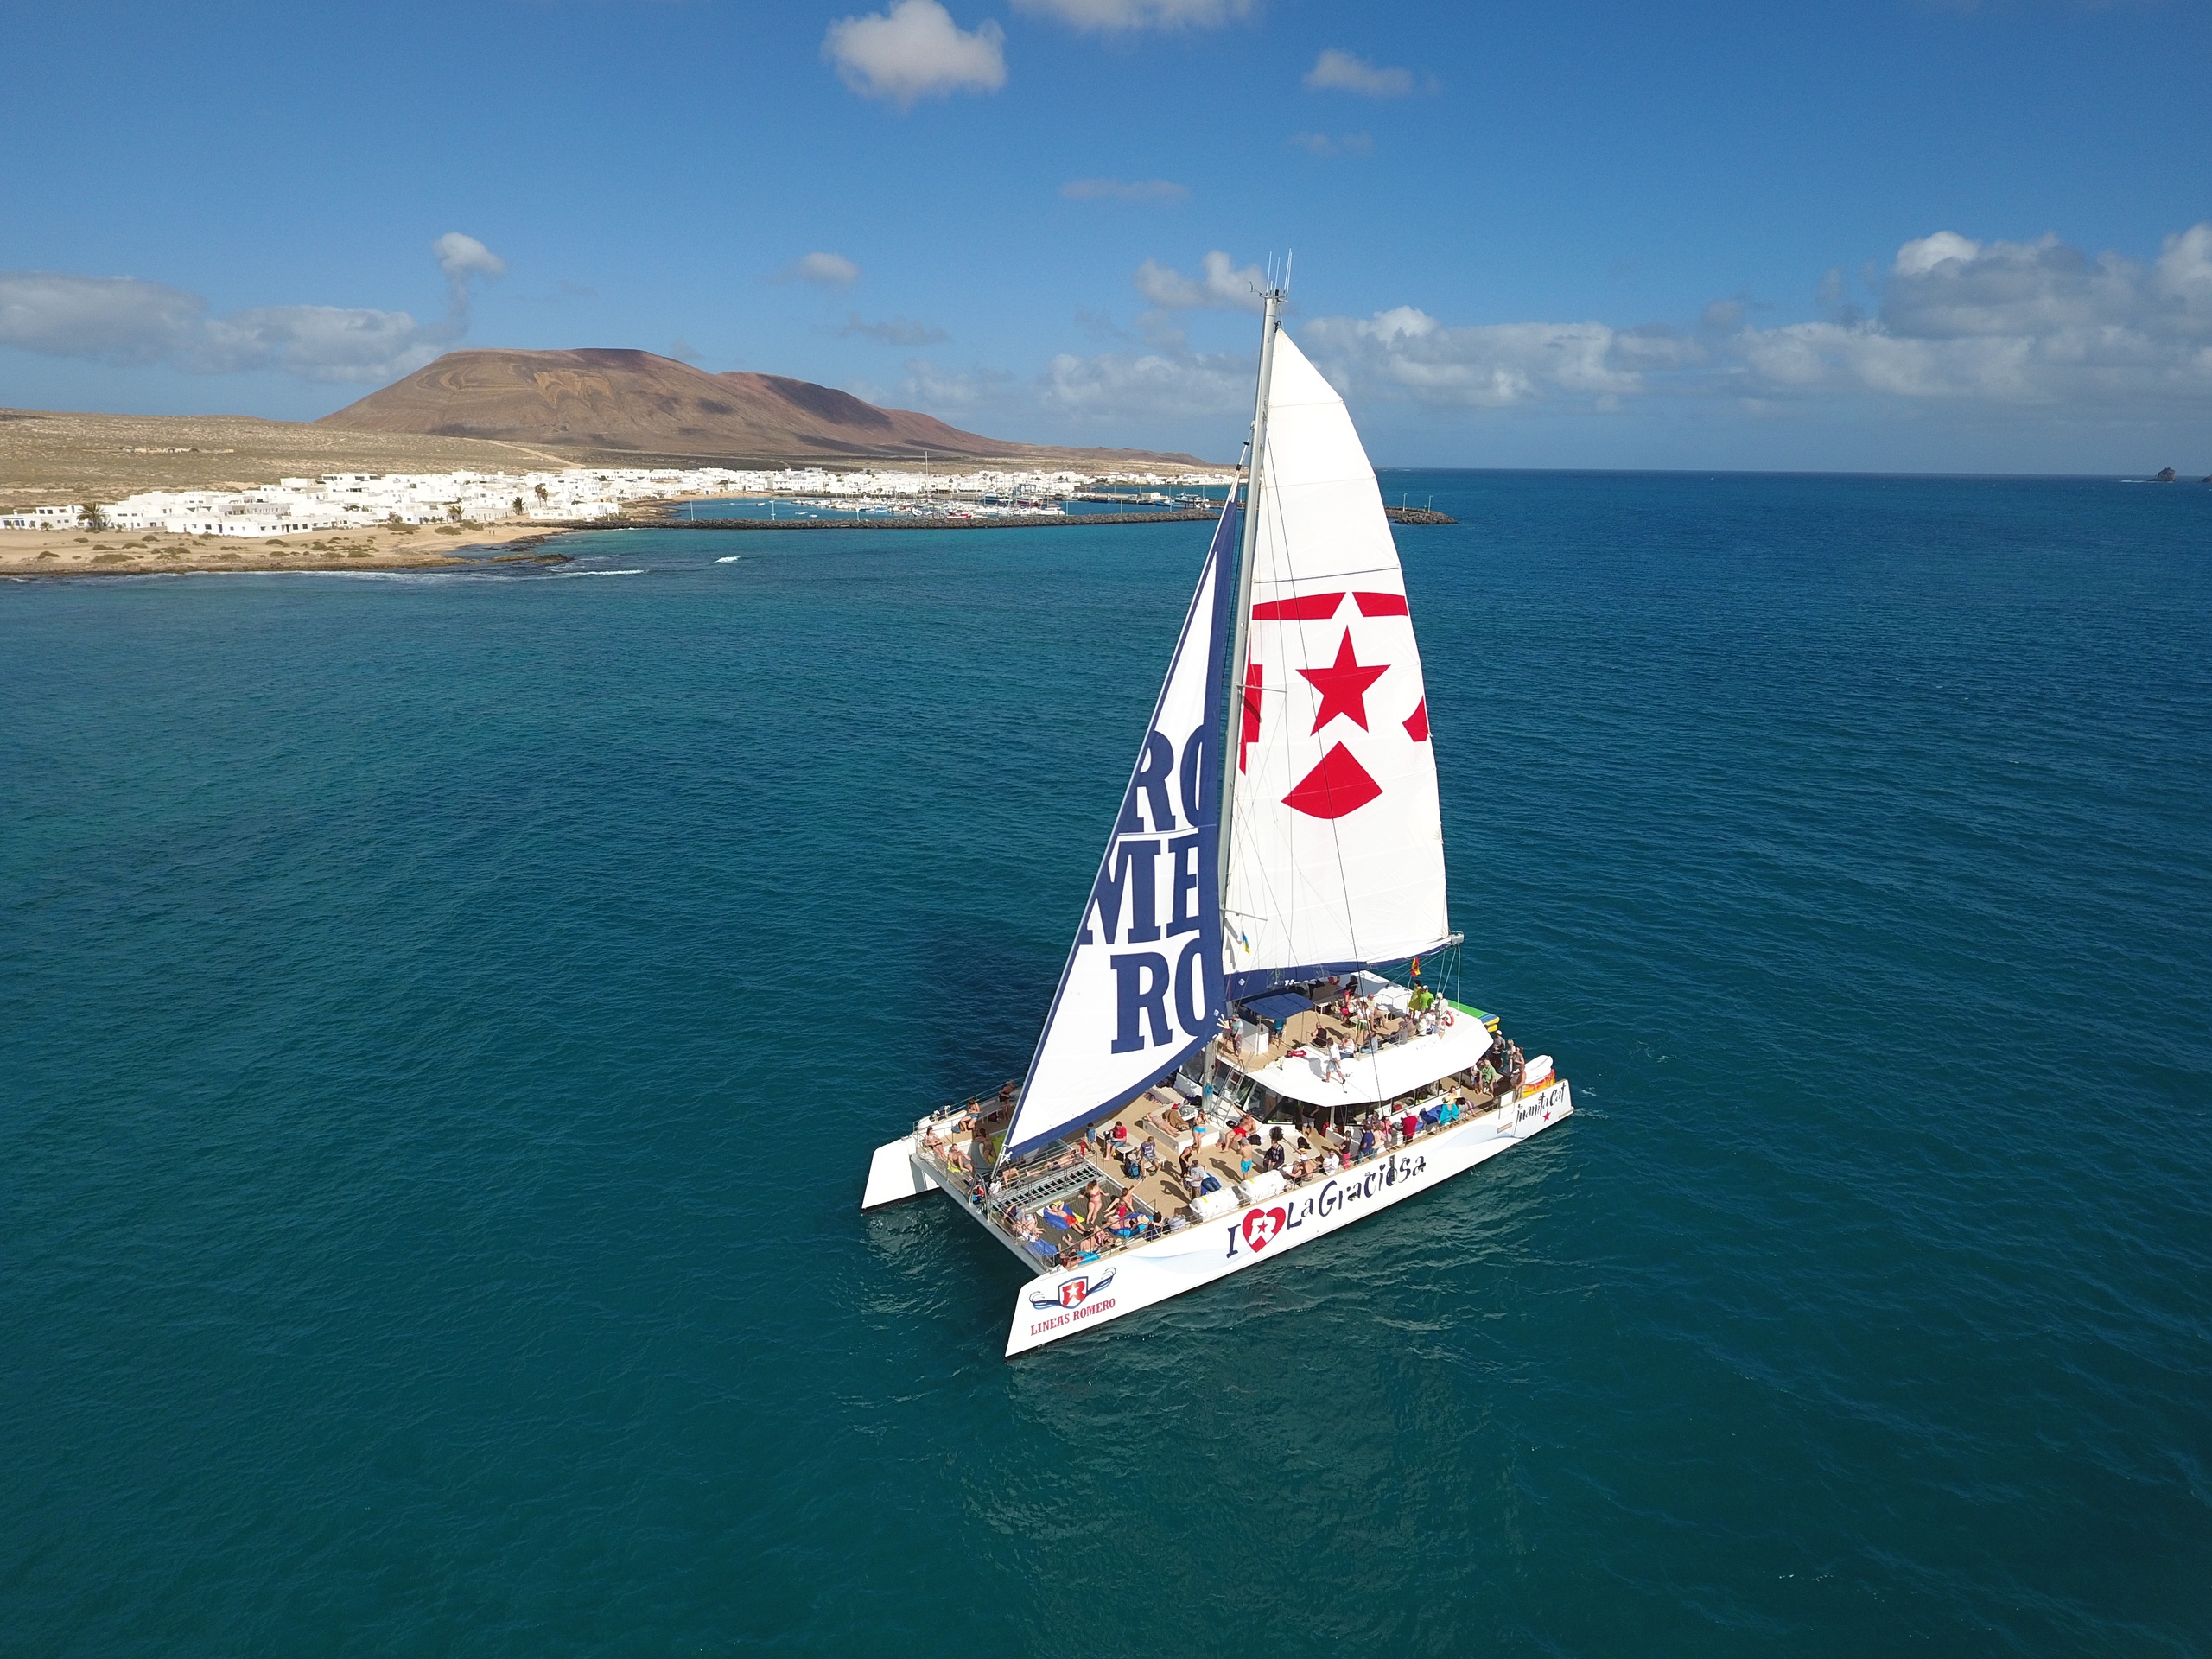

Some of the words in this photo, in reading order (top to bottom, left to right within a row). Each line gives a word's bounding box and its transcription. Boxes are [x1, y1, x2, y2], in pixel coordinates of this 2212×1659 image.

[1110, 938, 1208, 1054] RO
[1226, 1224, 1241, 1258] I
[1031, 1313, 1070, 1336] LINEAS
[1073, 1298, 1116, 1321] ROMERO
